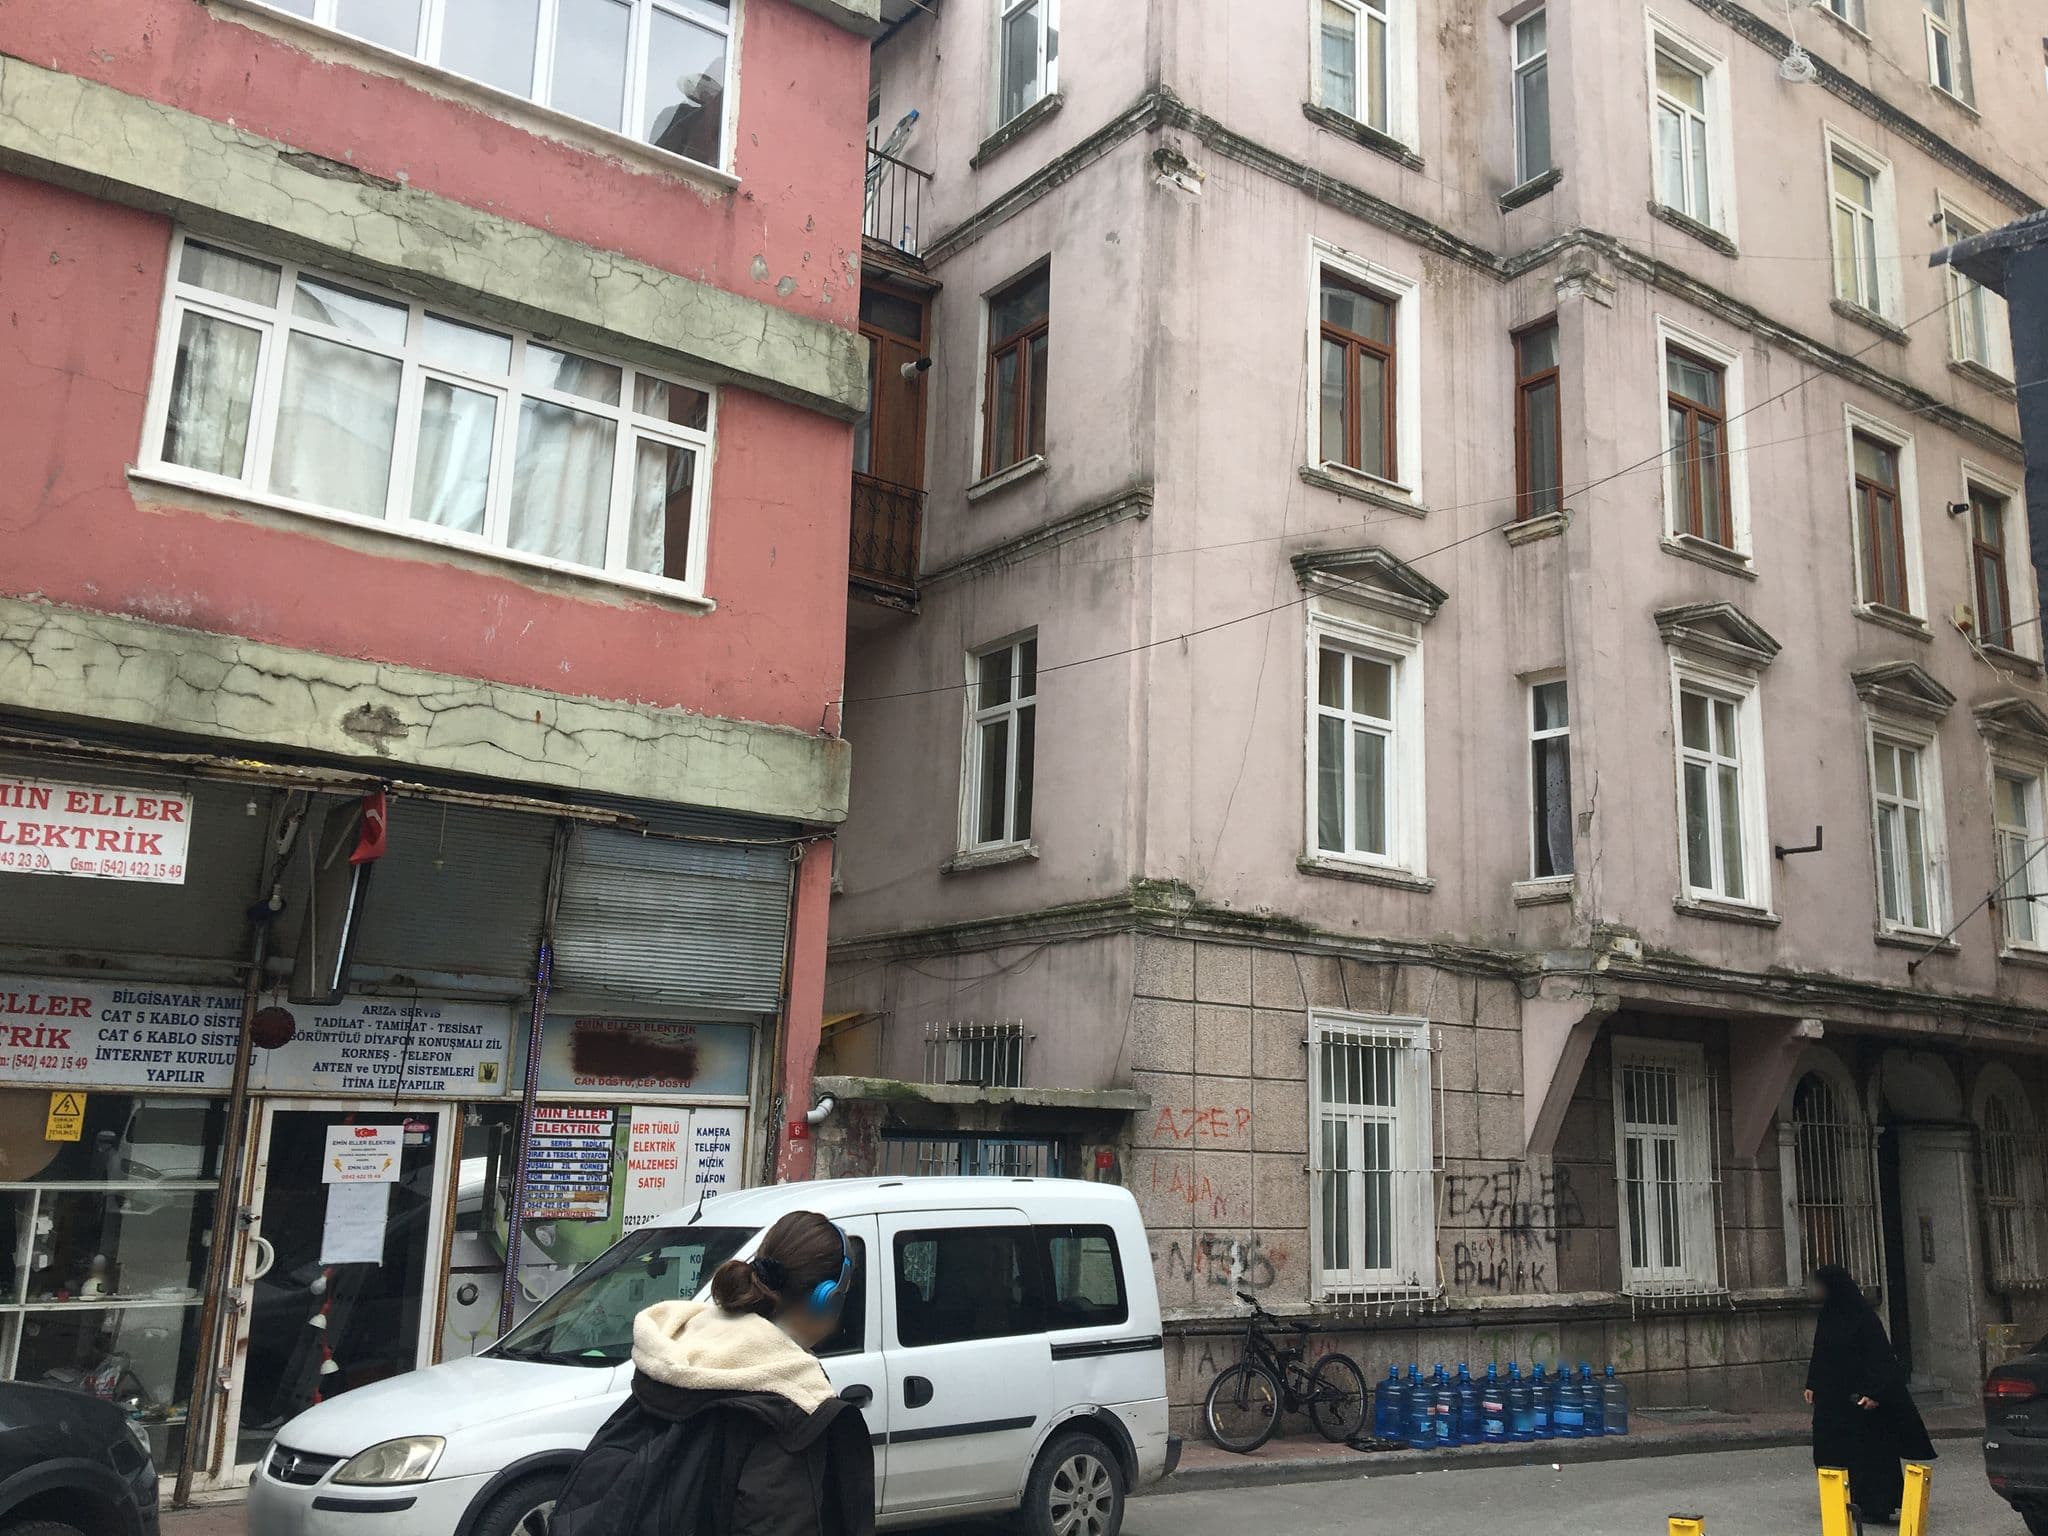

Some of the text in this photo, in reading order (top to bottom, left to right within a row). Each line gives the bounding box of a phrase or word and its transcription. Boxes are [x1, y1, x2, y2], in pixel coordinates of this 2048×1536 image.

[64, 790, 185, 823] ELLER
[18, 852, 32, 867] 23
[35, 854, 49, 868] 30
[70, 857, 97, 872] Gsm:
[100, 858, 127, 877] (542)
[130, 861, 150, 876] 422
[153, 863, 166, 877] 15
[169, 864, 183, 878] 49
[0, 992, 92, 1017] LLER
[112, 988, 201, 1008] BİLGİSAYAR
[101, 1009, 132, 1023] CAT
[136, 1011, 145, 1023] 5
[150, 1011, 200, 1026] KABLO
[362, 1005, 397, 1017] ARIZA
[314, 1016, 365, 1029] TADİLAT
[375, 1019, 427, 1032] TAMİRAT
[437, 1022, 483, 1035] TESİSAT
[98, 1028, 129, 1042] CAT
[133, 1030, 142, 1043] 6
[146, 1031, 197, 1045] KABLO
[364, 1033, 416, 1046] DİYAFON
[418, 1037, 483, 1050] KONUŞMALI
[485, 1039, 502, 1050] ZİL
[12, 1054, 37, 1071] (542)
[39, 1055, 57, 1069] 422
[61, 1056, 74, 1069] 15
[75, 1057, 88, 1069] 49
[95, 1044, 257, 1066] İNTERNET KURULUU
[341, 1048, 390, 1062] KORNEŞ
[400, 1050, 453, 1062] TELEFON
[147, 1069, 205, 1083] YAPILIR
[312, 1061, 475, 1077] ANTEN ve UYDU SİSTEMLERİ
[342, 1075, 446, 1091] İTİNA İLE YAPILIR
[574, 1077, 595, 1086] CAN
[637, 1079, 657, 1088] CEP
[566, 1109, 608, 1120] ELLER
[632, 1121, 680, 1135] HER TÜRLÜ
[1153, 1106, 1251, 1140] AZER
[696, 1127, 731, 1137] KAMERA
[633, 1138, 676, 1153] ELEKTRİK
[694, 1142, 731, 1153] TELEFON
[628, 1157, 679, 1171] MALZEMESİ
[698, 1156, 725, 1168] MÜZİK
[638, 1177, 666, 1191] SATIŞI
[695, 1172, 726, 1184] DİAFON
[624, 1215, 641, 1226] 0212
[1453, 1240, 1549, 1294] BURAK
